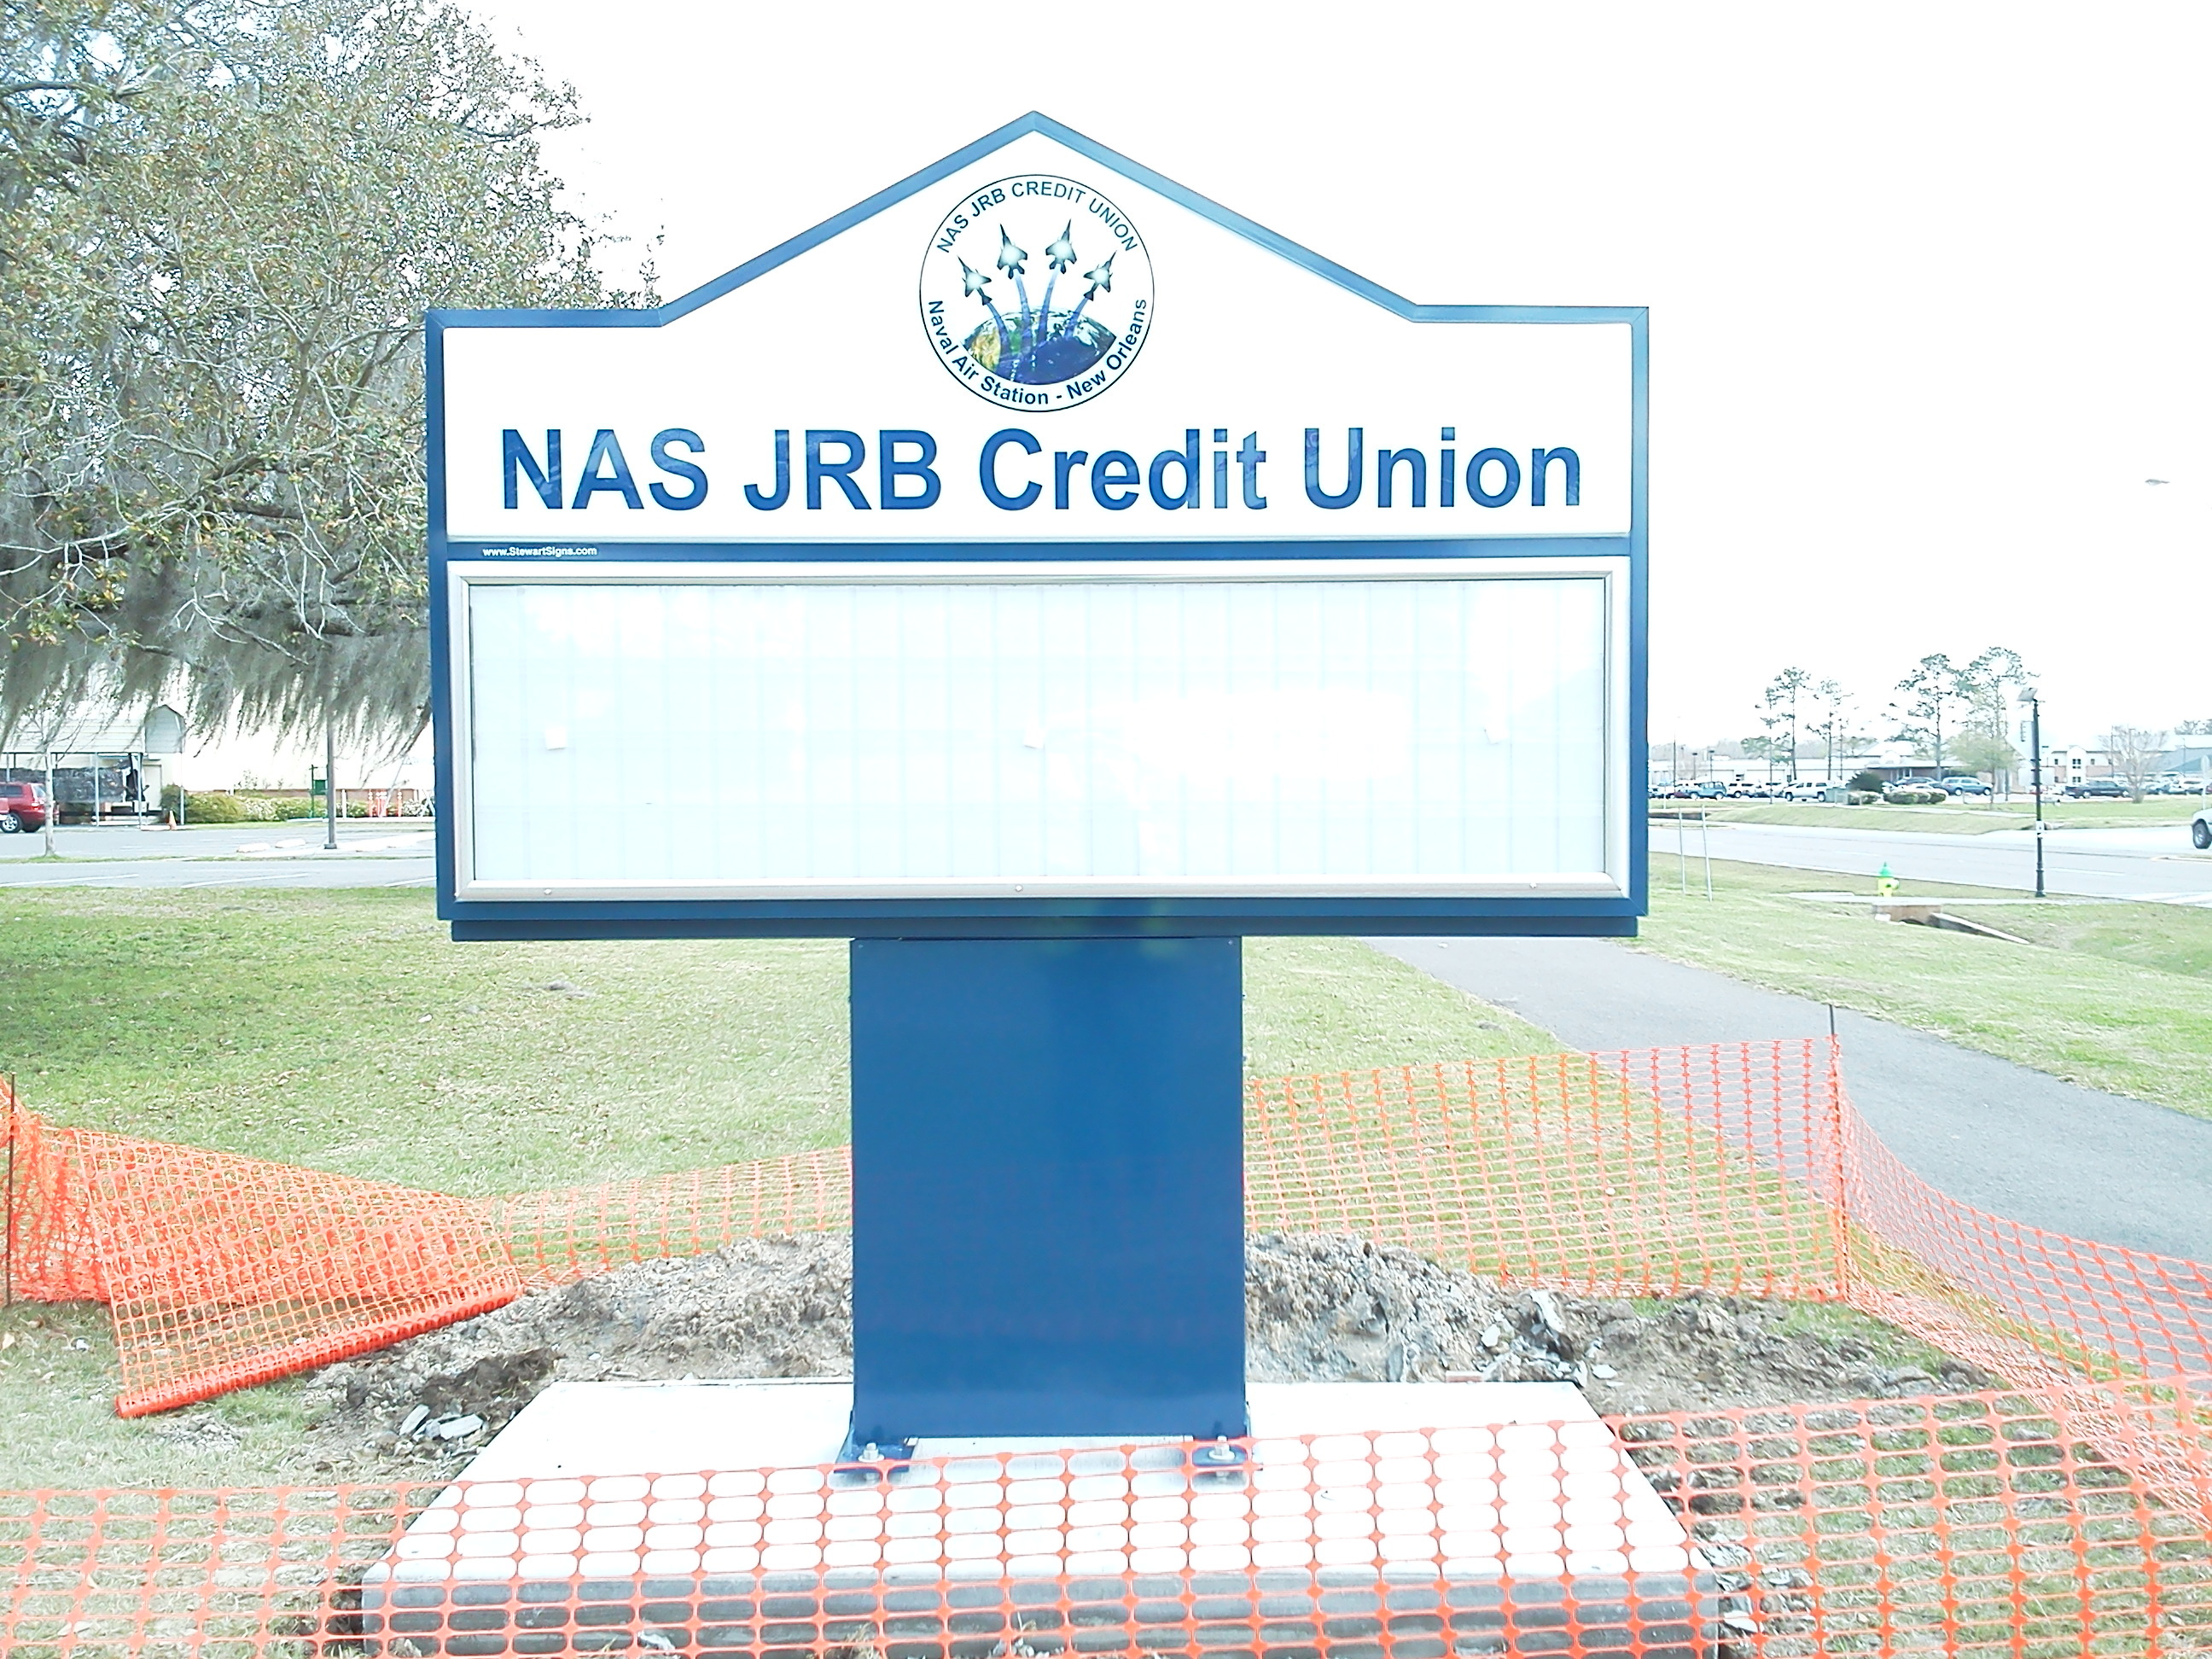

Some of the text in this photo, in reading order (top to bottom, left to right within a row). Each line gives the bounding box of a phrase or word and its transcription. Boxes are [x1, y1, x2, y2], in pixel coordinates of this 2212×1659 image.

[937, 181, 1138, 253] NAS JRB CREDIT UNION
[928, 300, 959, 355] Naval
[952, 355, 979, 381] Air
[981, 375, 1049, 405] Station
[1066, 370, 1107, 399] New
[1106, 299, 1147, 371] Orleans
[502, 426, 1580, 512] NAS JRB Credit Union
[482, 546, 597, 557] www.StewartSigns.com
